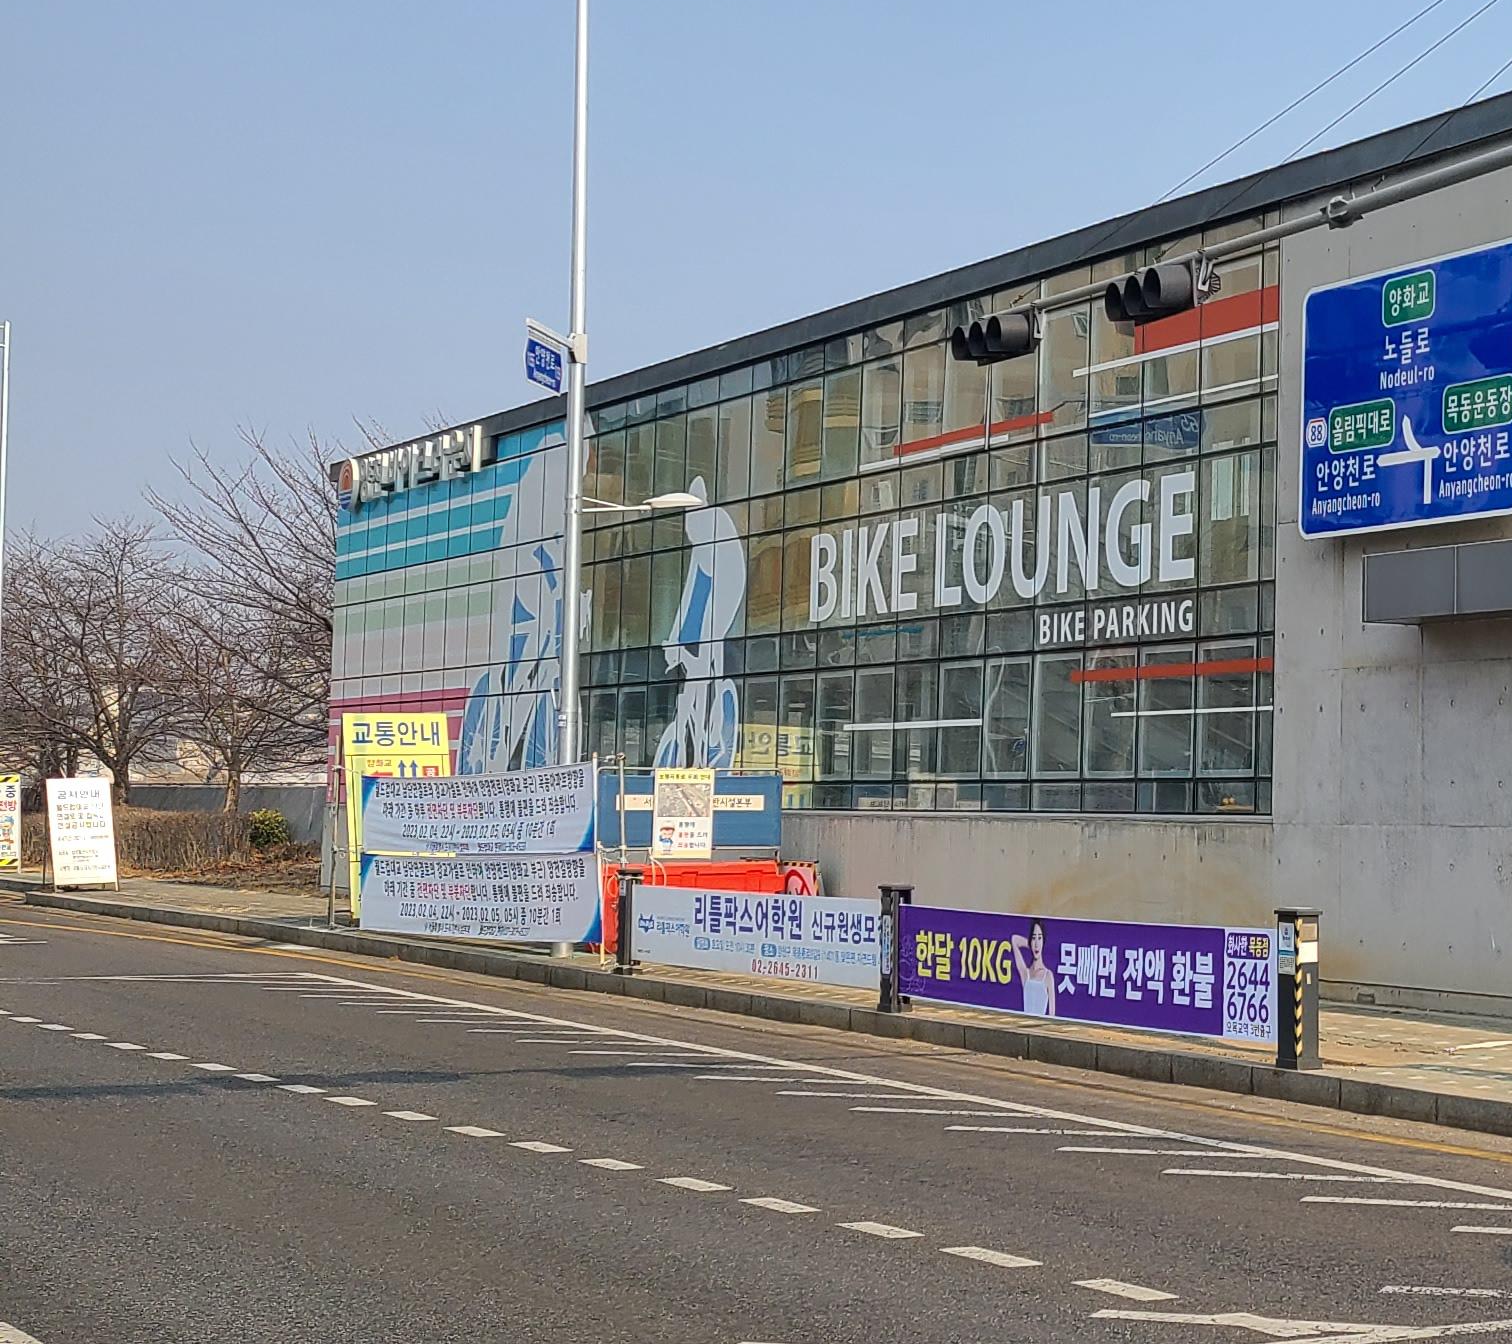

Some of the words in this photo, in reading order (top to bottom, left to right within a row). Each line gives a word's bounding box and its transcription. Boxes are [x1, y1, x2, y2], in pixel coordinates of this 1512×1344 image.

[1388, 284, 1430, 316] 양화교
[1383, 327, 1430, 365] 노들로
[1379, 365, 1435, 390] Nodeul-ro
[1447, 386, 1512, 424] 목동운동장
[1310, 423, 1323, 442] 88
[1332, 409, 1391, 446] 올림픽대로
[1443, 432, 1511, 473] 안양천로
[1316, 456, 1376, 492] 안양천로
[1312, 492, 1380, 517] Anyangcheon-ro
[810, 518, 918, 622] BIKE
[933, 471, 1196, 608] LOUNGE
[1039, 609, 1085, 645] BIKE
[1093, 600, 1193, 640] PARKING
[352, 721, 441, 747] 교통안내
[694, 893, 802, 940] 리틀팍스어학원
[812, 910, 881, 945] 신규원생모
[752, 959, 818, 980] 02-2645-2311
[915, 929, 954, 981] 한달
[958, 936, 1013, 985] 10KG
[1057, 942, 1117, 998] 못빼면
[1122, 949, 1166, 1003] 전액
[1170, 950, 1216, 1009] 환불
[1226, 960, 1270, 992] 2644
[1227, 991, 1269, 1023] 6766
